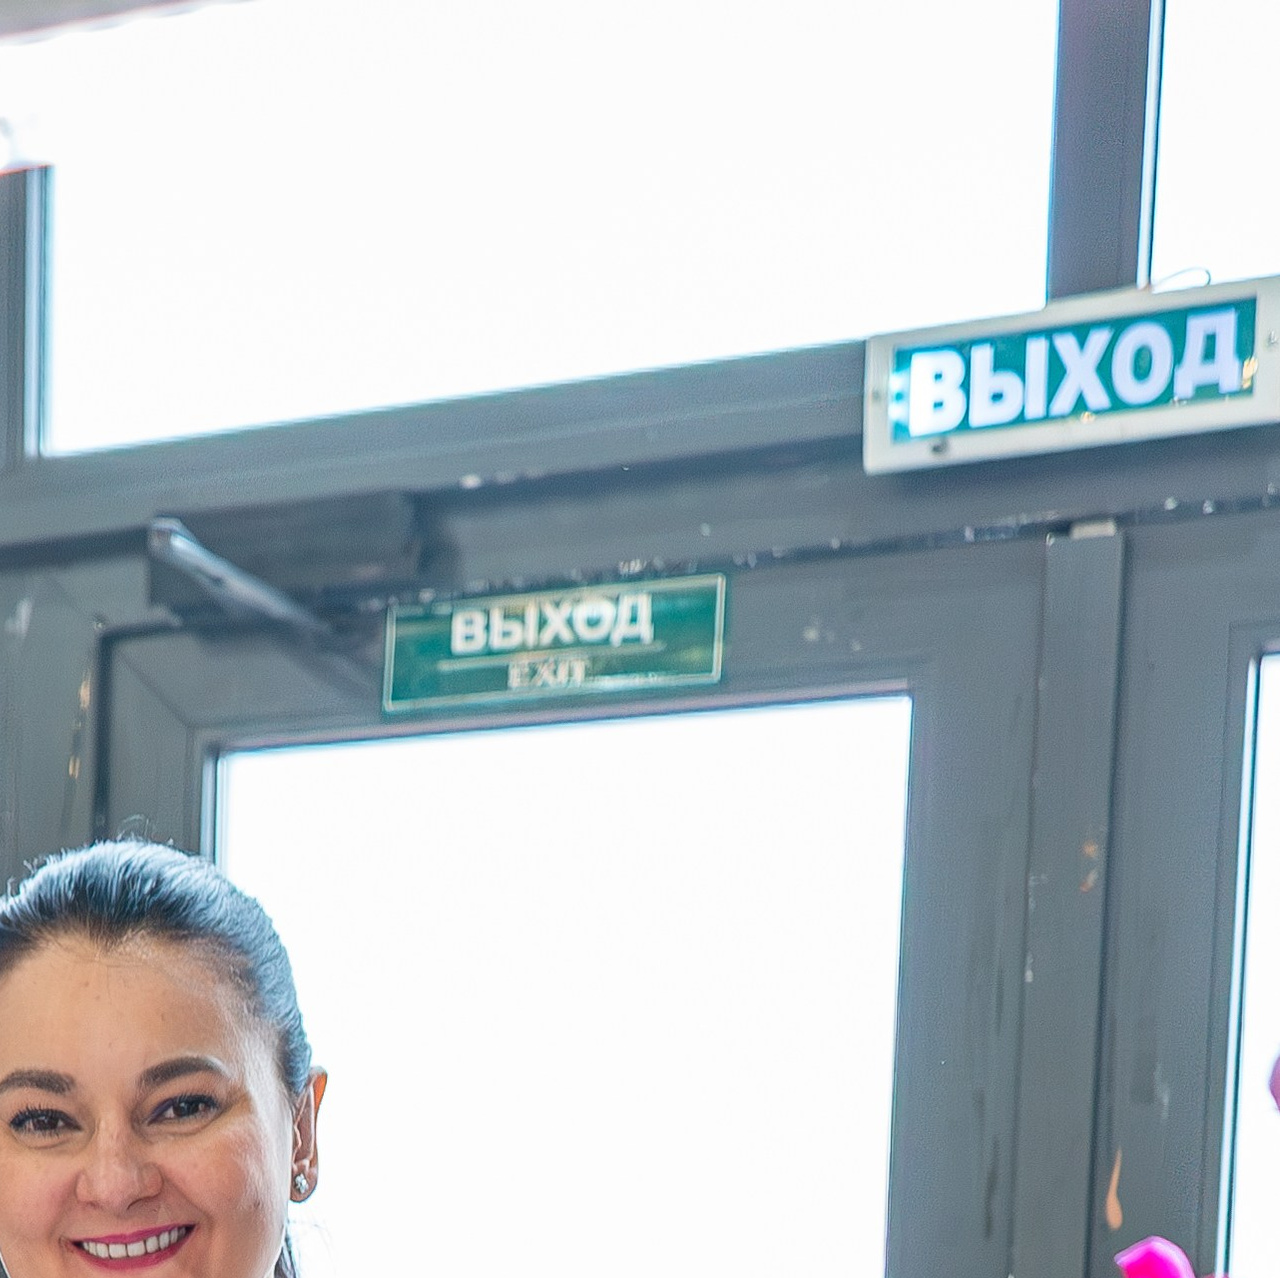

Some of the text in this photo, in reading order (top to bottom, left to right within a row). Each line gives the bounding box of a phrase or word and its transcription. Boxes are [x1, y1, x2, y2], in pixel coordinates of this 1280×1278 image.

[908, 306, 1242, 438] ВЫХОД
[450, 592, 654, 656] ВЫХОД
[507, 655, 586, 690] EXIT
